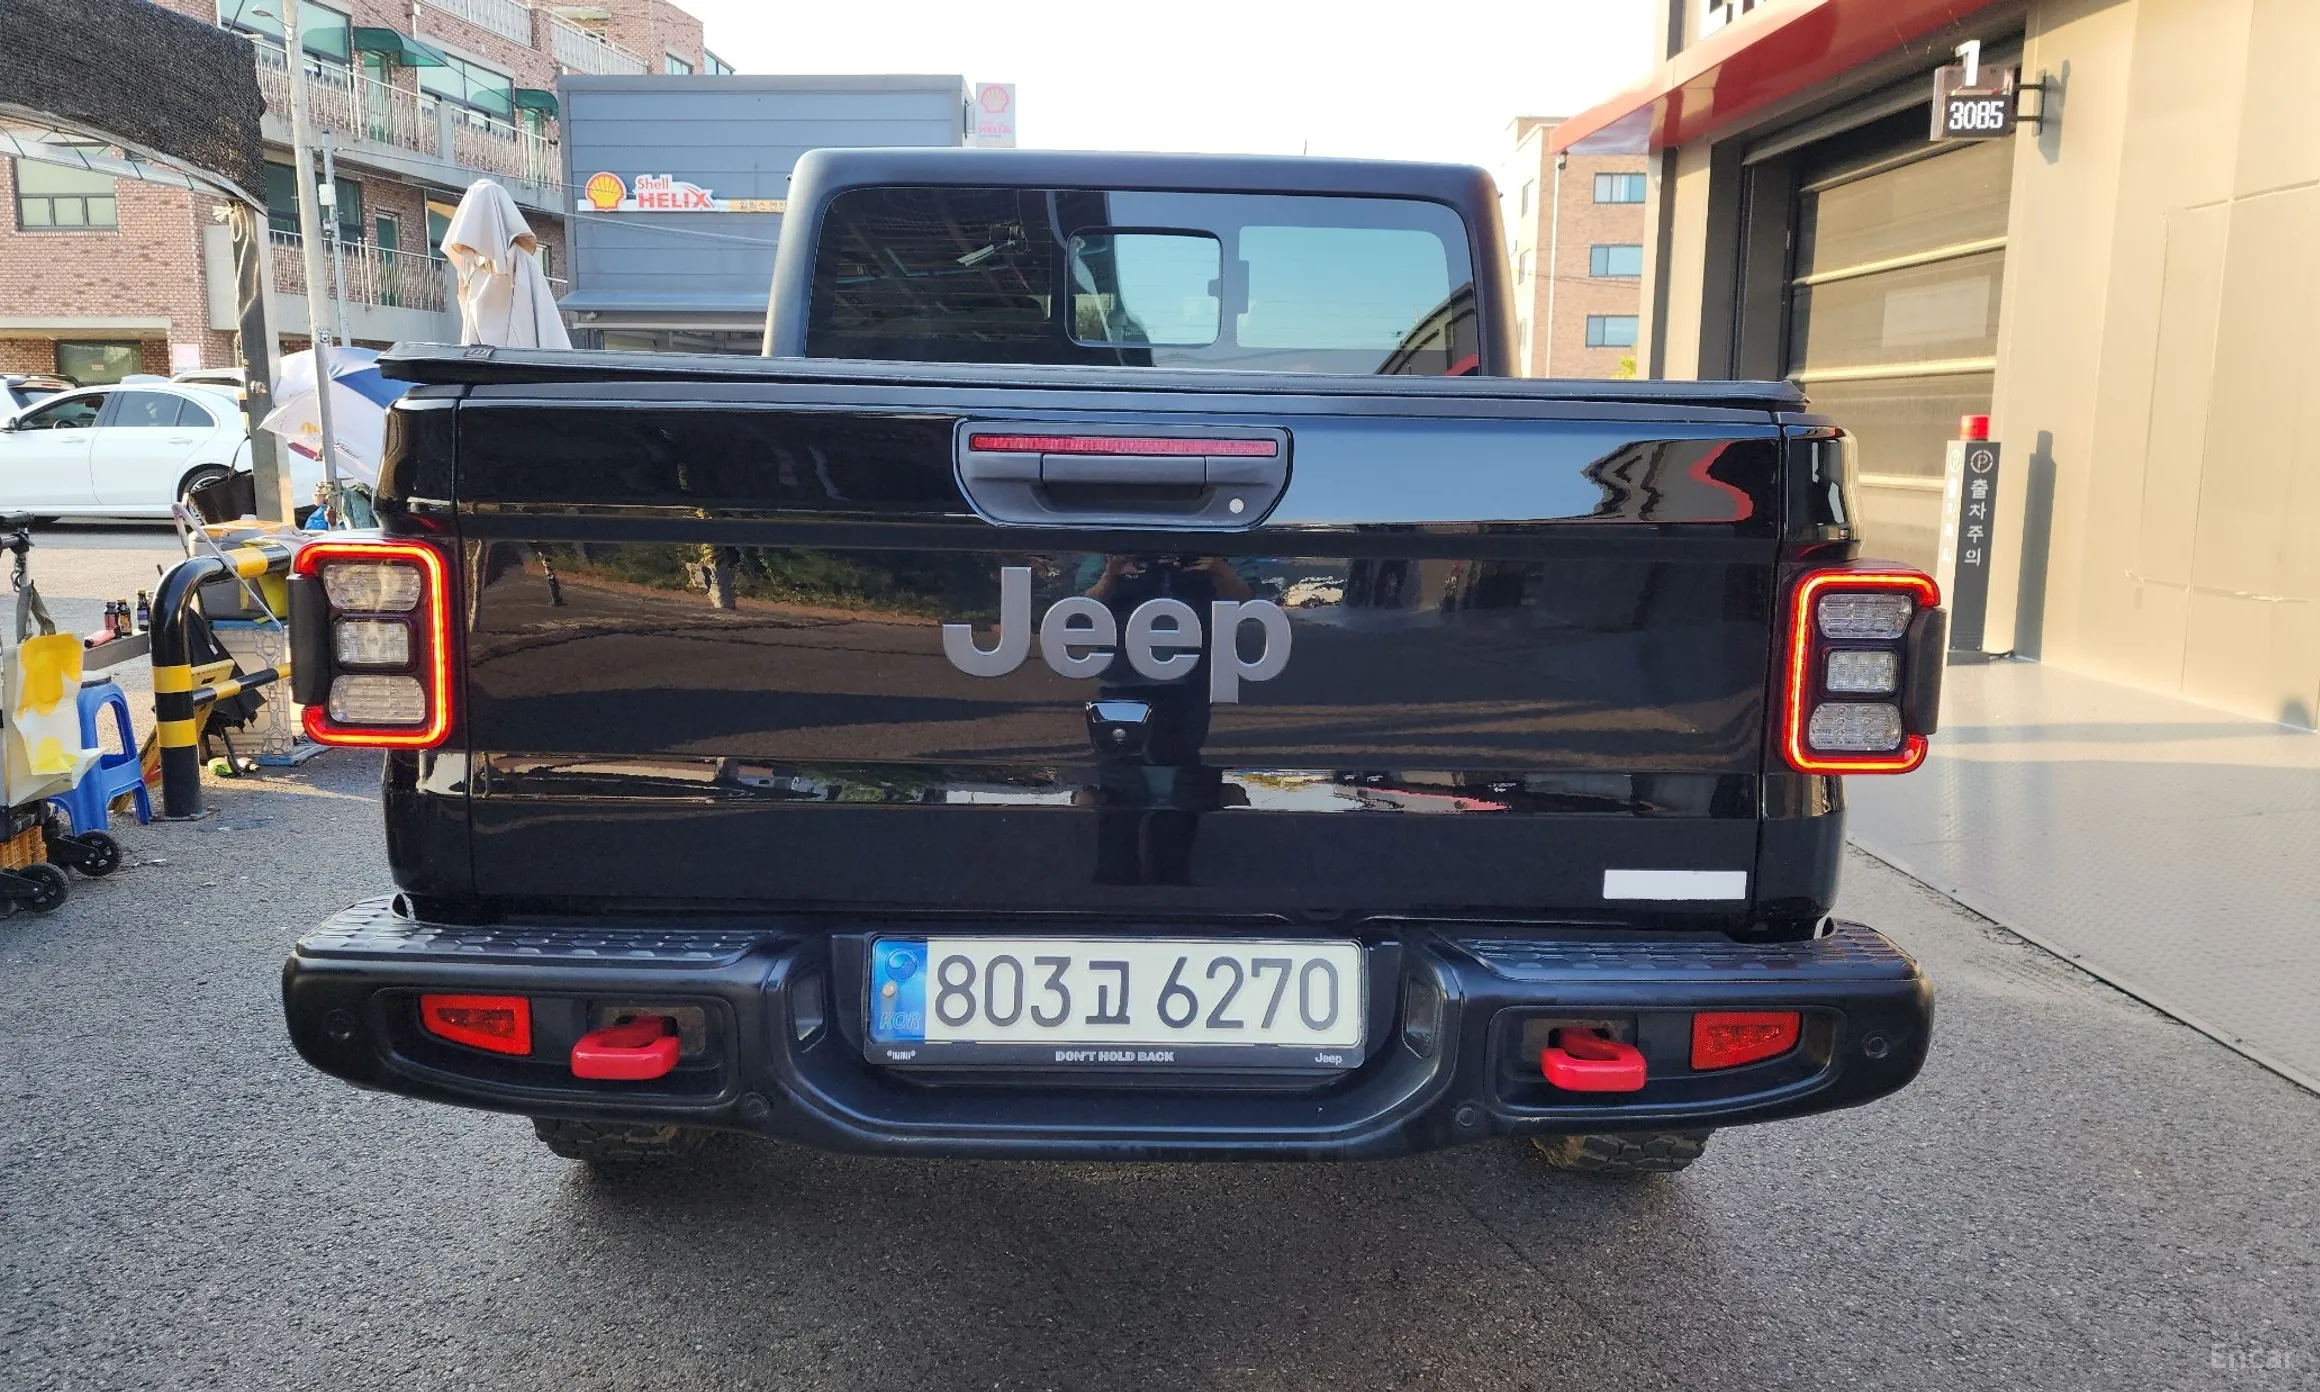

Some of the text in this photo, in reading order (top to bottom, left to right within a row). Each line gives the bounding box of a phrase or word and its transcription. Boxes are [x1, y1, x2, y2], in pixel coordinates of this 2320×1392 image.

[1955, 39, 1981, 87] 1
[1949, 101, 2005, 129] 3085
[637, 177, 669, 190] Shell
[638, 192, 712, 209] HELIX
[942, 566, 1292, 704] Jeep
[934, 954, 1340, 1032] 803고 6270
[879, 1011, 922, 1031] KOR
[1055, 1050, 1175, 1062] DON'T HOLD BACK
[1315, 1052, 1343, 1066] Jeep
